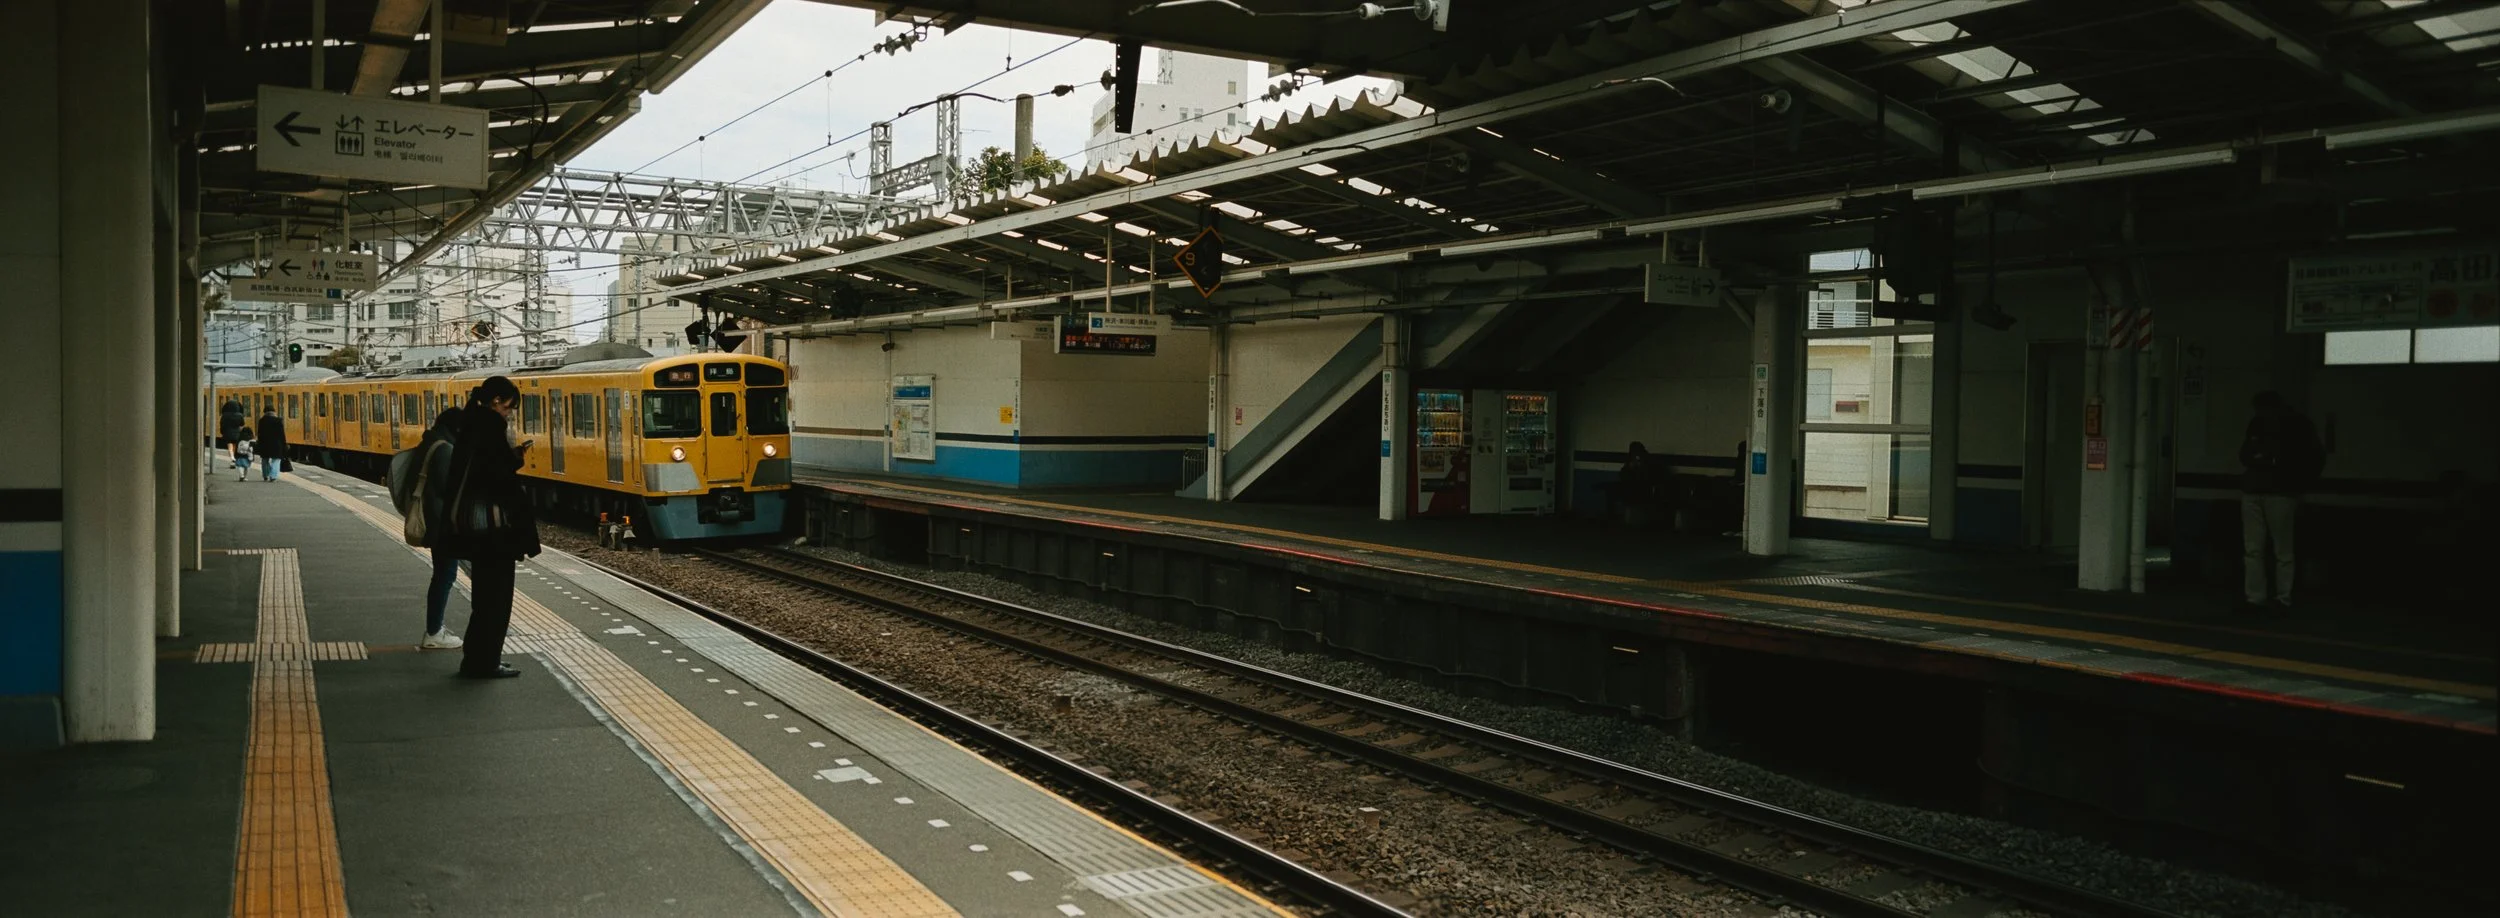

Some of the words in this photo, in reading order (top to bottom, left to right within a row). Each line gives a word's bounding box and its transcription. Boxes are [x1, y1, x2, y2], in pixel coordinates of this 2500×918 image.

[374, 119, 474, 140] エレベーター
[374, 137, 416, 149] Elevator
[334, 259, 364, 270] 化粧室
[1186, 252, 1195, 266] 9
[1096, 319, 1101, 327] 2
[1757, 388, 1765, 418] 下落合
